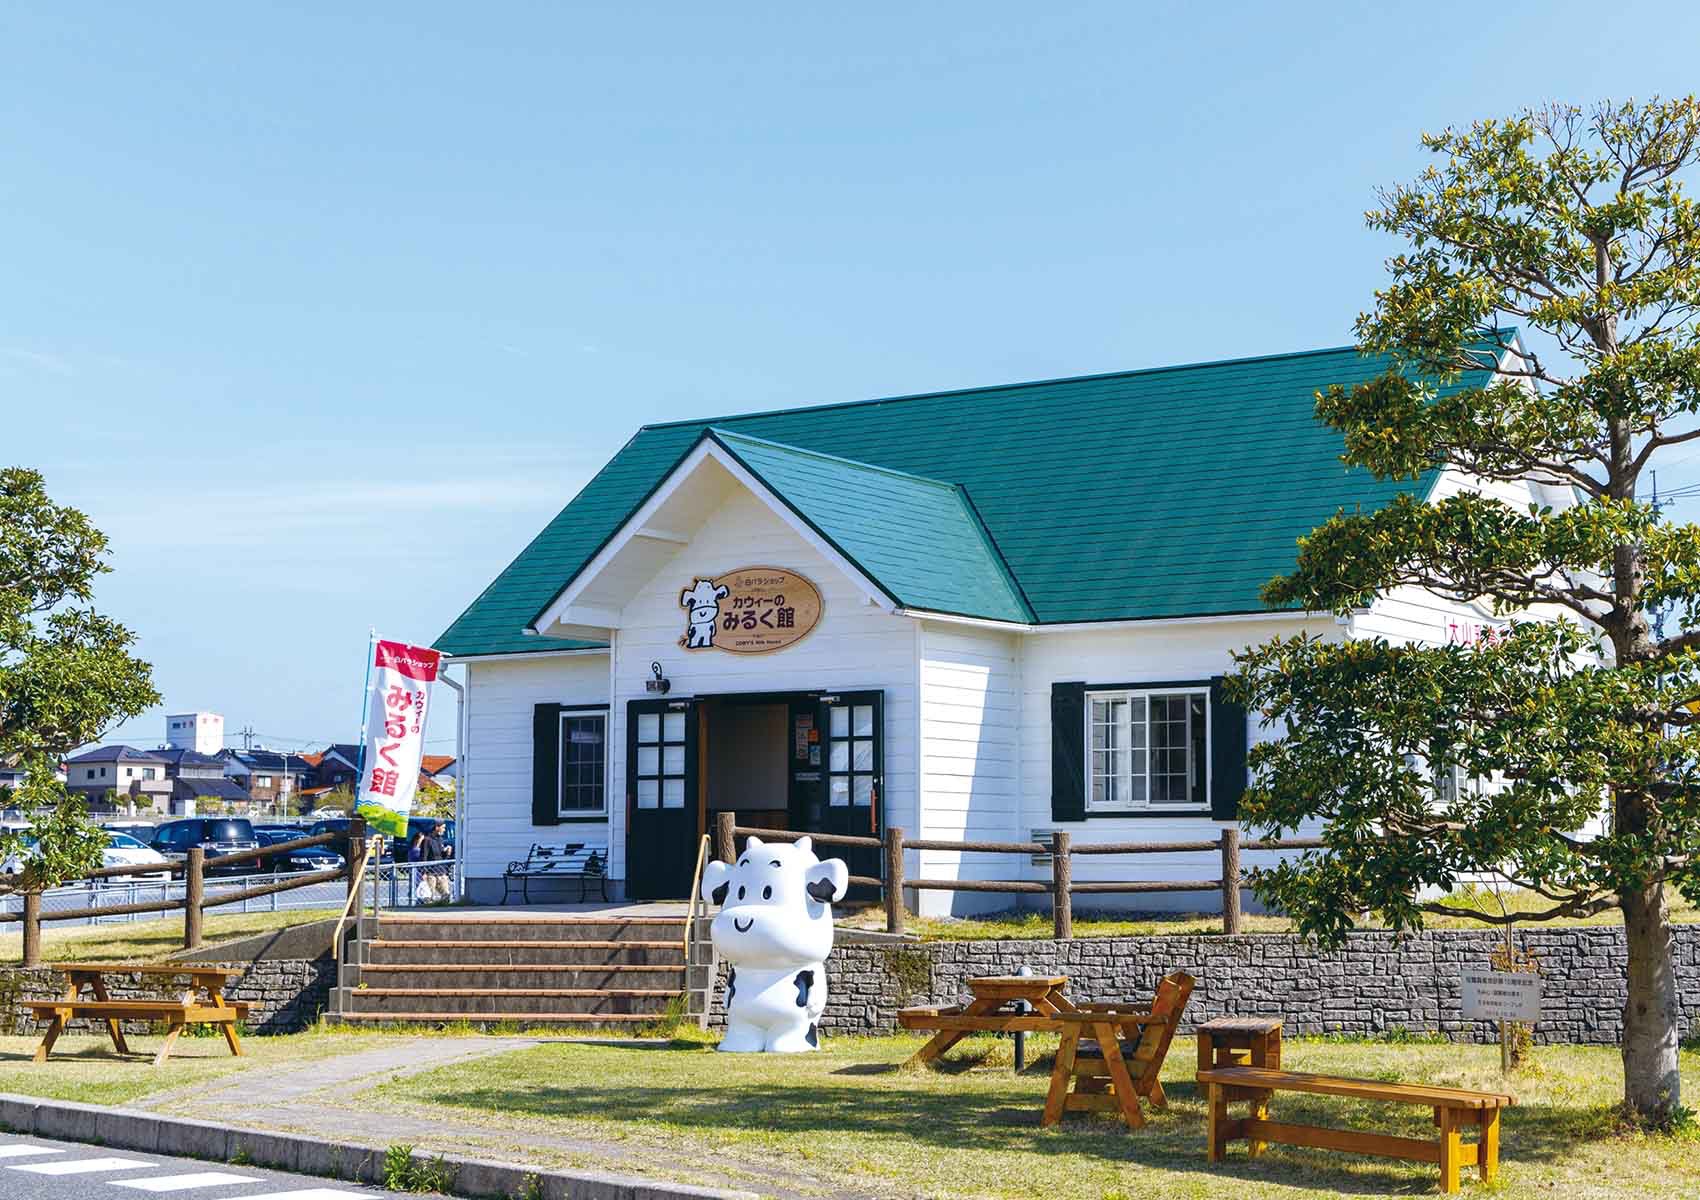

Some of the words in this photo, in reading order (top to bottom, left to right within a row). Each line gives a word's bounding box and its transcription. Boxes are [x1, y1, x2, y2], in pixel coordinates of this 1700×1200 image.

[733, 594, 785, 609] カウィーの
[723, 607, 795, 630] みるく館
[411, 690, 425, 734] カウィーの
[369, 684, 412, 797] みるく館
